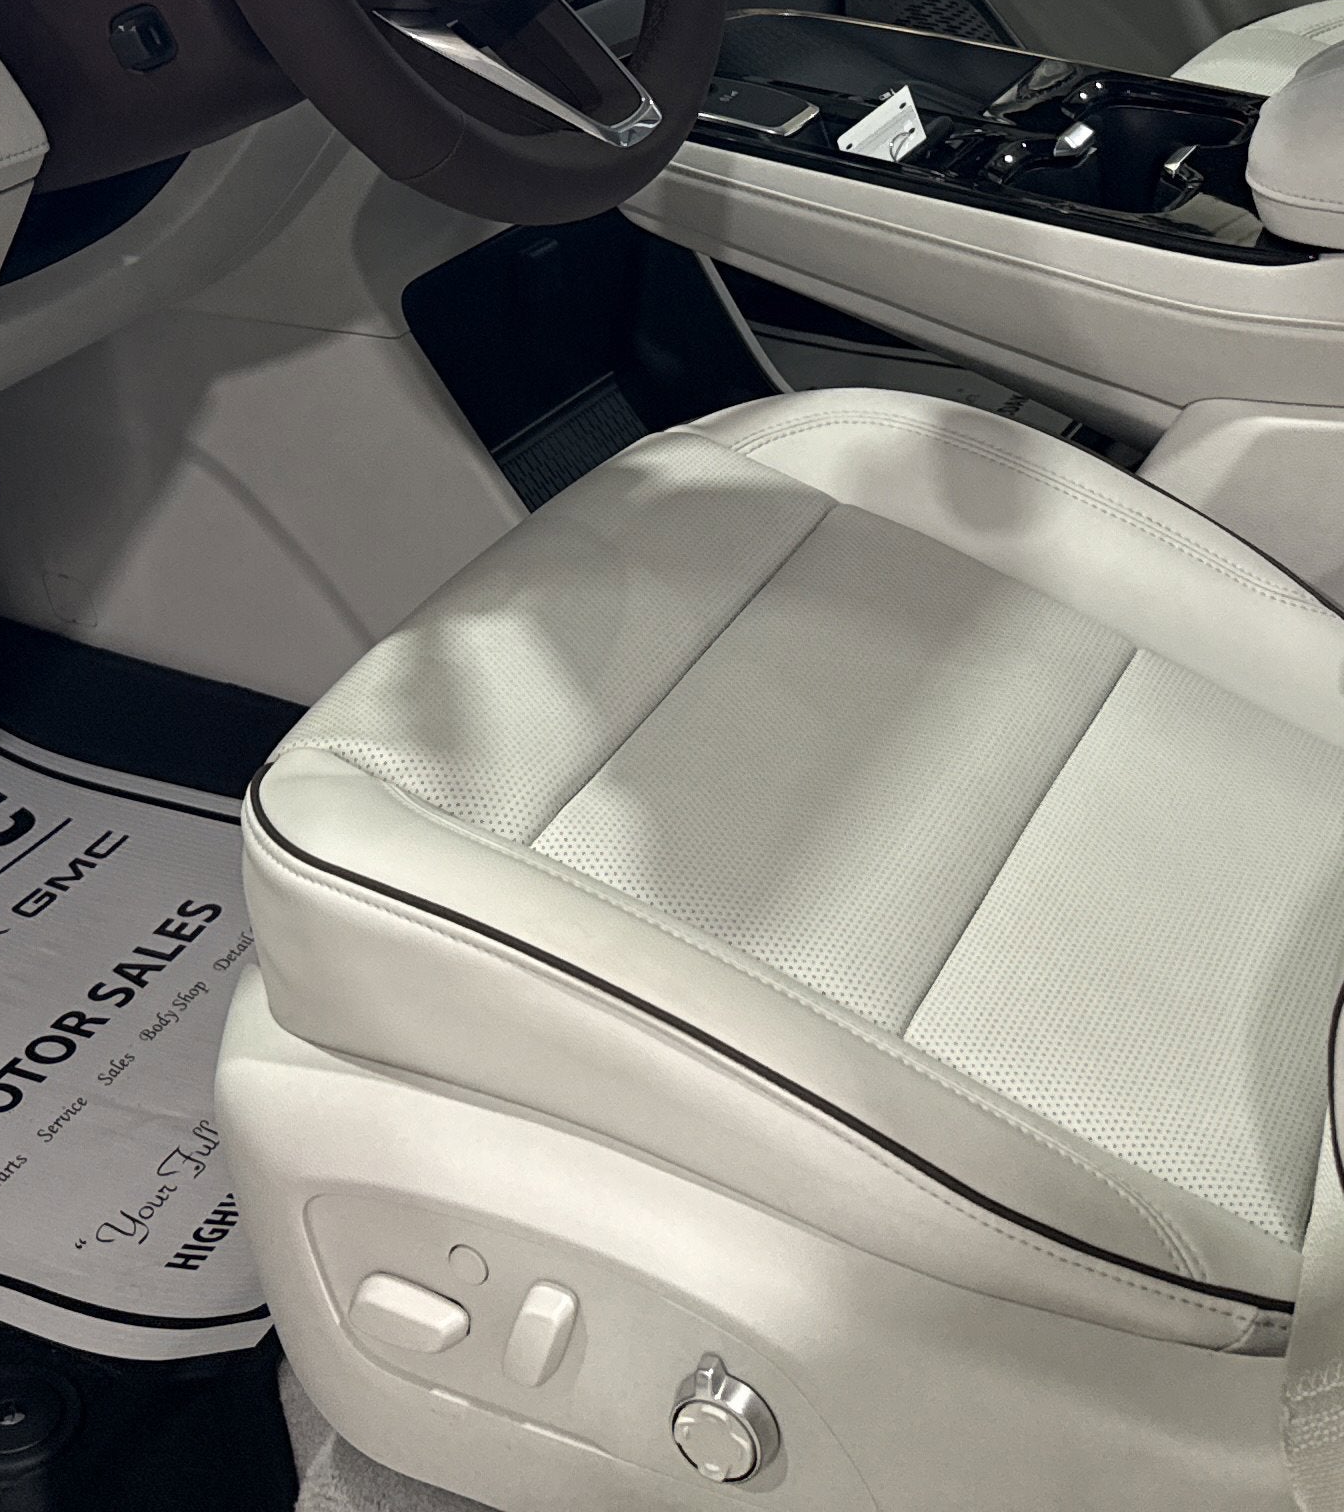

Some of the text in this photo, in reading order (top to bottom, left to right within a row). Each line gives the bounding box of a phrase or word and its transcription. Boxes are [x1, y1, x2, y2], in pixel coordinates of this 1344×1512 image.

[11, 830, 130, 917] GMC
[87, 899, 223, 1008] SALES
[37, 1096, 87, 1143] Service
[97, 1053, 135, 1086] Sales
[139, 1010, 180, 1041] Body
[172, 980, 209, 1012] Shop
[212, 925, 255, 971] Detail
[157, 1119, 220, 1179] Full
